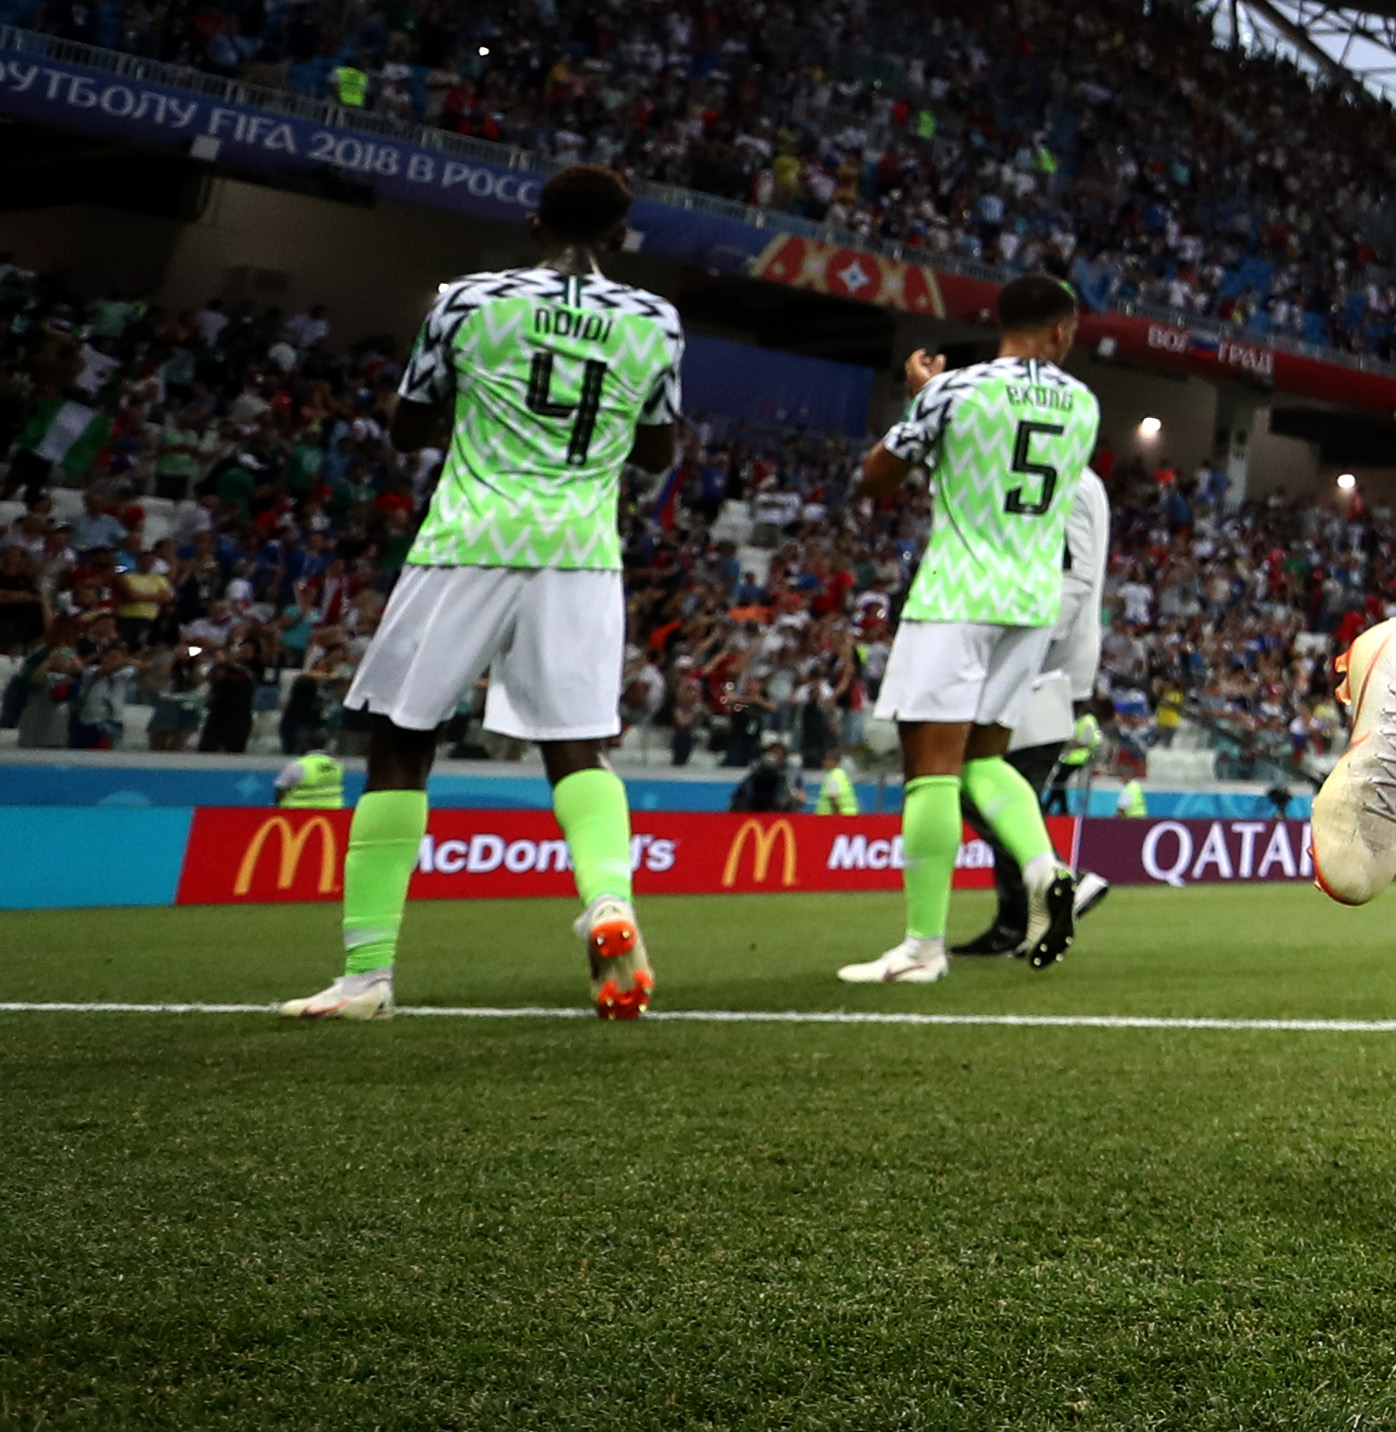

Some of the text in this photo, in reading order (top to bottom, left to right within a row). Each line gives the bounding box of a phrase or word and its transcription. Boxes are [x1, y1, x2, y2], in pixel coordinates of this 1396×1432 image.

[0, 61, 199, 129] УТБОЛУ
[208, 107, 298, 154] FIFA
[308, 131, 400, 176] 2018
[441, 161, 543, 208] РОСС
[526, 352, 607, 466] 4
[1004, 420, 1065, 515] 5
[420, 834, 676, 873] cDon's
[1141, 821, 1313, 887] QATA
